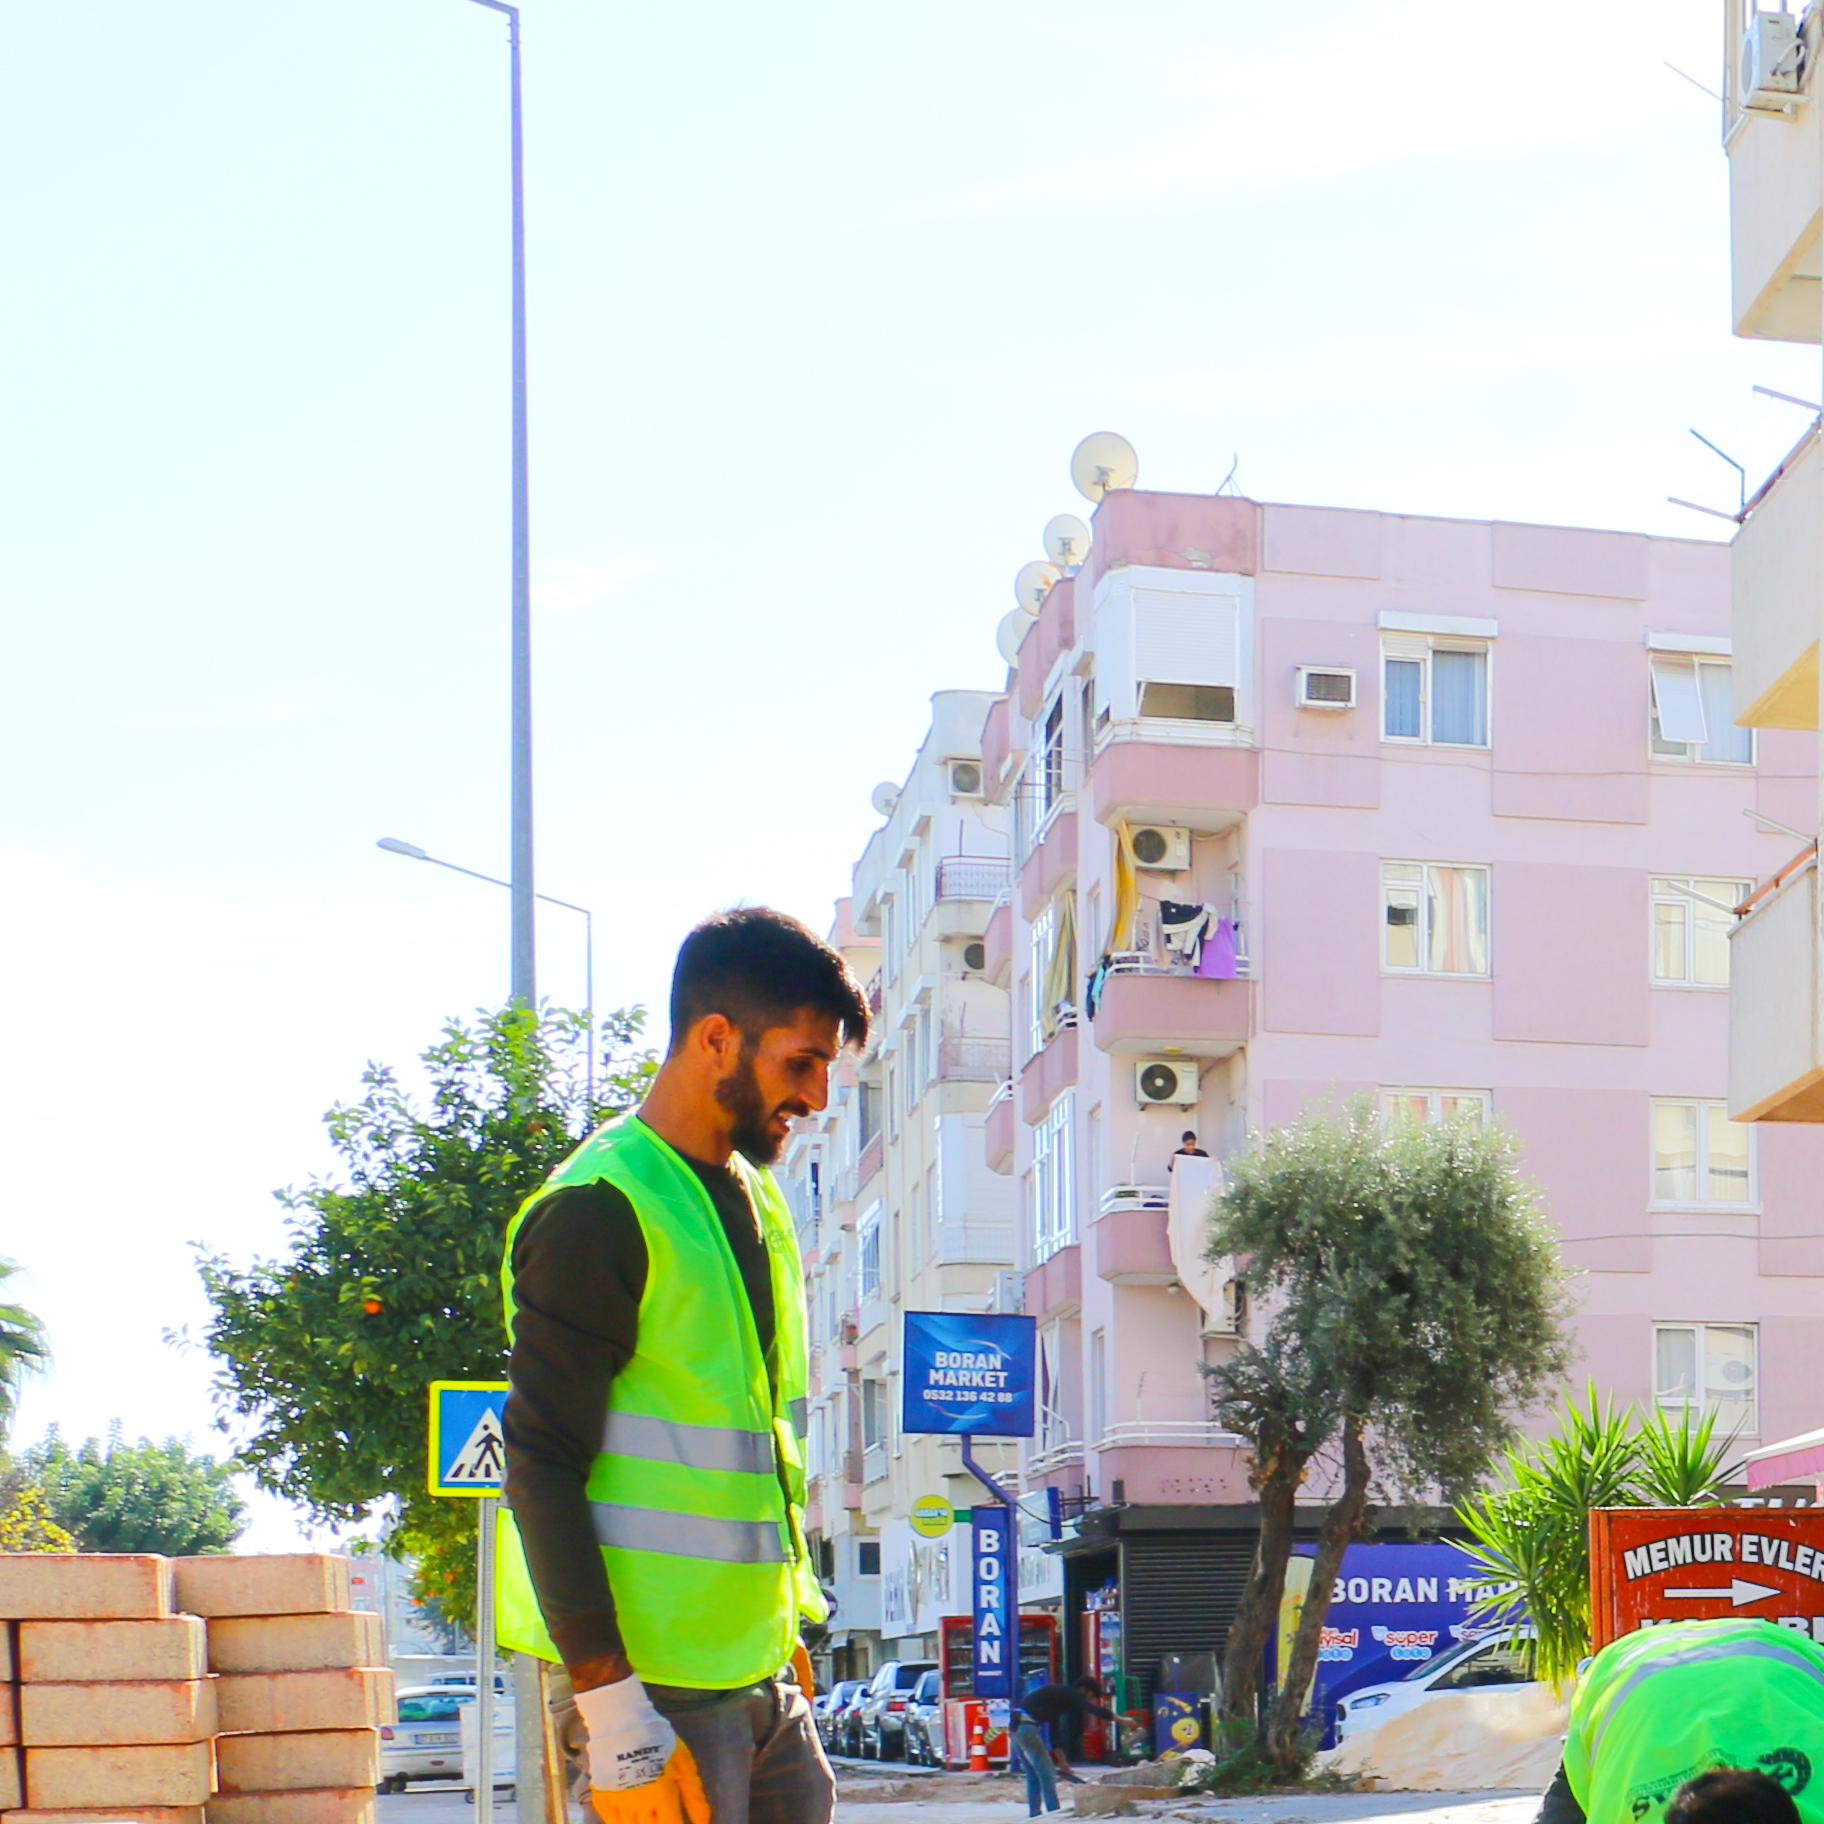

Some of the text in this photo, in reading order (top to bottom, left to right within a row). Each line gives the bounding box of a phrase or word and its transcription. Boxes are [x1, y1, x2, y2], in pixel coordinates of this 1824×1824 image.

[935, 1351, 1002, 1370] BORAN
[929, 1369, 1008, 1388] MARKET
[979, 1392, 995, 1402] 42
[1624, 1532, 1734, 1581] MEMUR
[979, 1529, 1001, 1663] BORAN
[1331, 1577, 1438, 1604] BORAN
